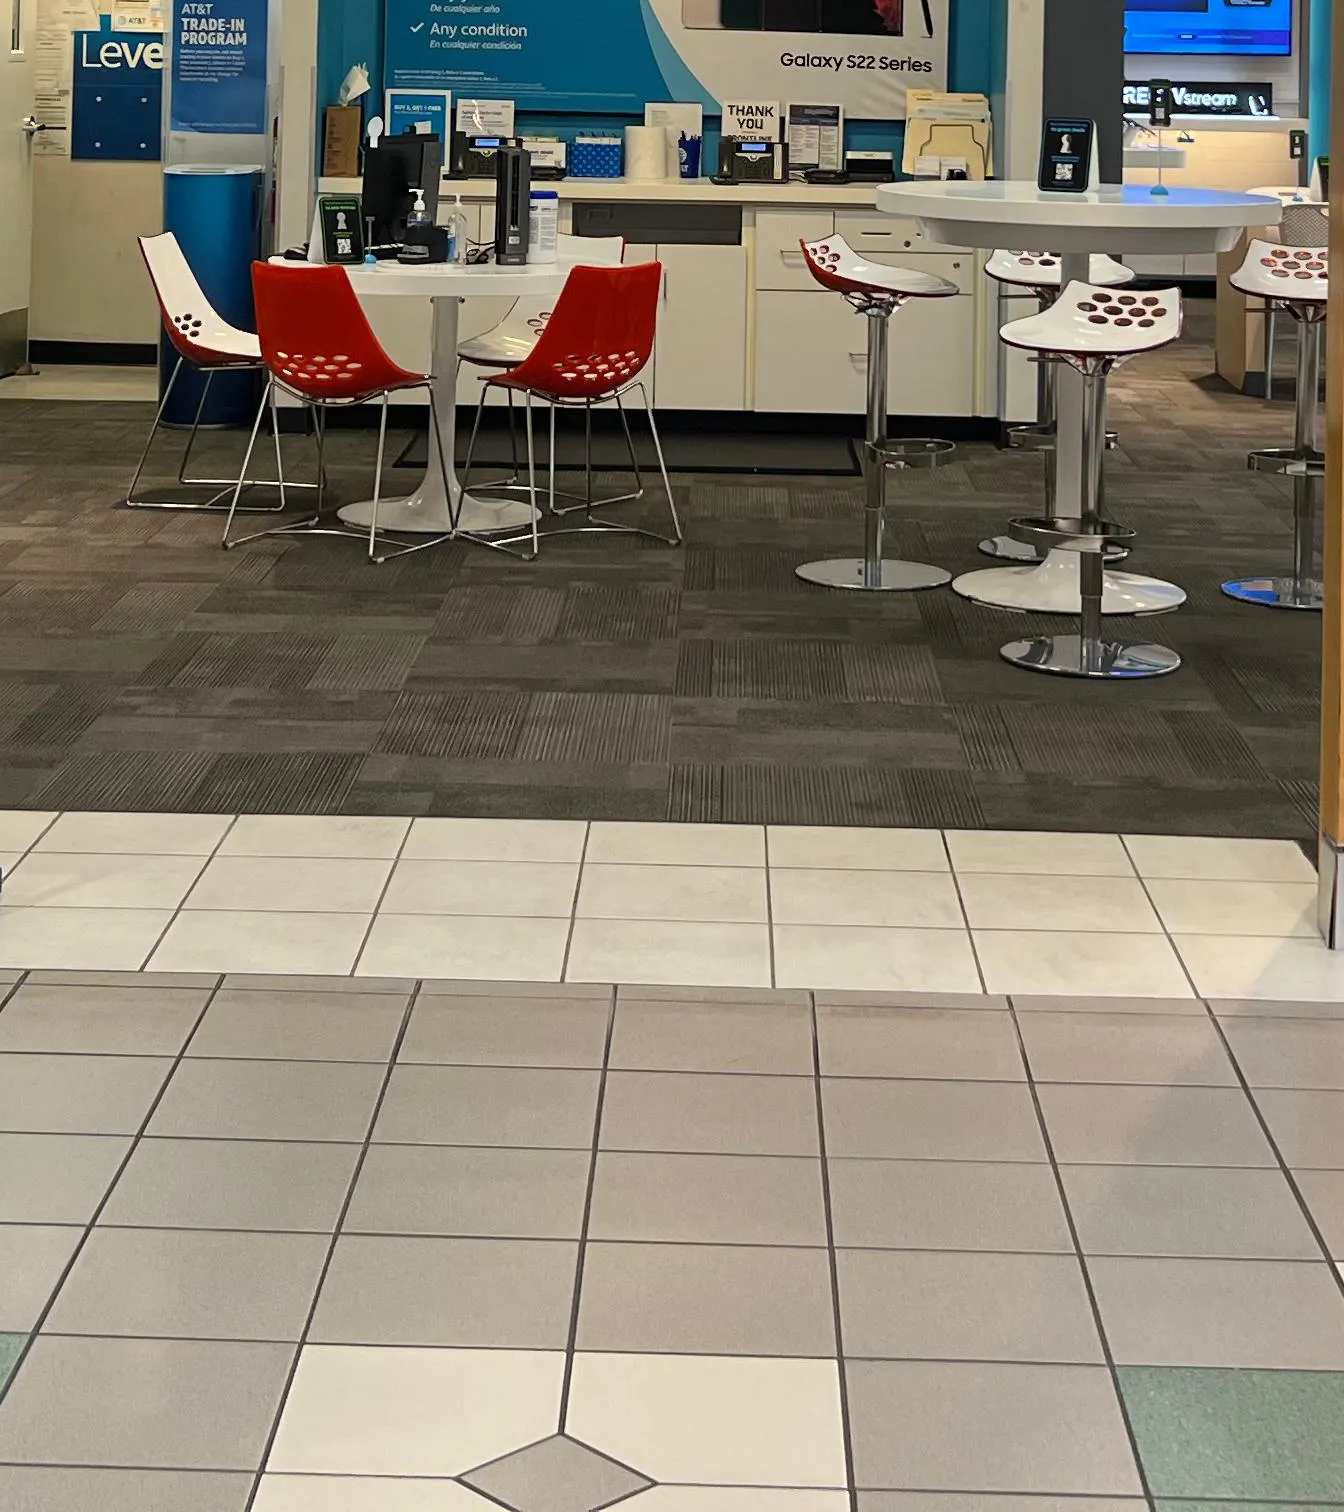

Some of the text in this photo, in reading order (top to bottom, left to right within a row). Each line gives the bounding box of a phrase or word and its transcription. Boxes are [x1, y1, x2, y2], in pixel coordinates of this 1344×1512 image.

[181, 3, 214, 15] AT&T
[430, 4, 441, 12] De
[443, 4, 483, 14] cualquier
[181, 17, 245, 31] TRADE-IN
[430, 22, 528, 38] Any condition
[181, 32, 248, 45] PROGRAM
[429, 40, 441, 48] En
[442, 40, 480, 50] cualquier
[779, 52, 933, 73] Galaxy S22 Series
[727, 104, 775, 118] THANK
[737, 118, 764, 130] YOU
